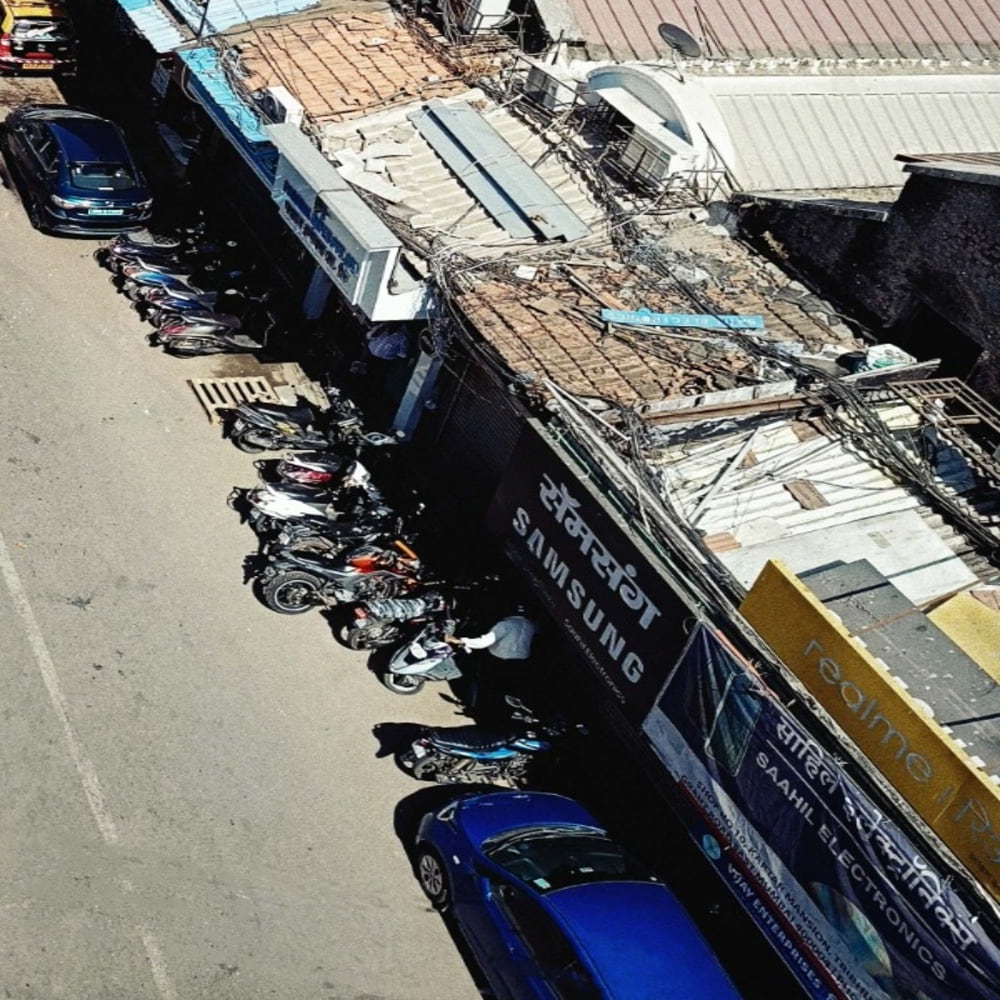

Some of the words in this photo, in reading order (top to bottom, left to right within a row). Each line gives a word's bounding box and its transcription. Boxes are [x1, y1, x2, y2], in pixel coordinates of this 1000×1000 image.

[512, 507, 644, 683] SAMSUNG
[776, 715, 840, 795] साहिल
[803, 639, 934, 783] realme
[756, 752, 815, 826] SAAHIL
[817, 824, 946, 981] ELECTRONICS
[752, 899, 822, 989] ENTERPRISES
